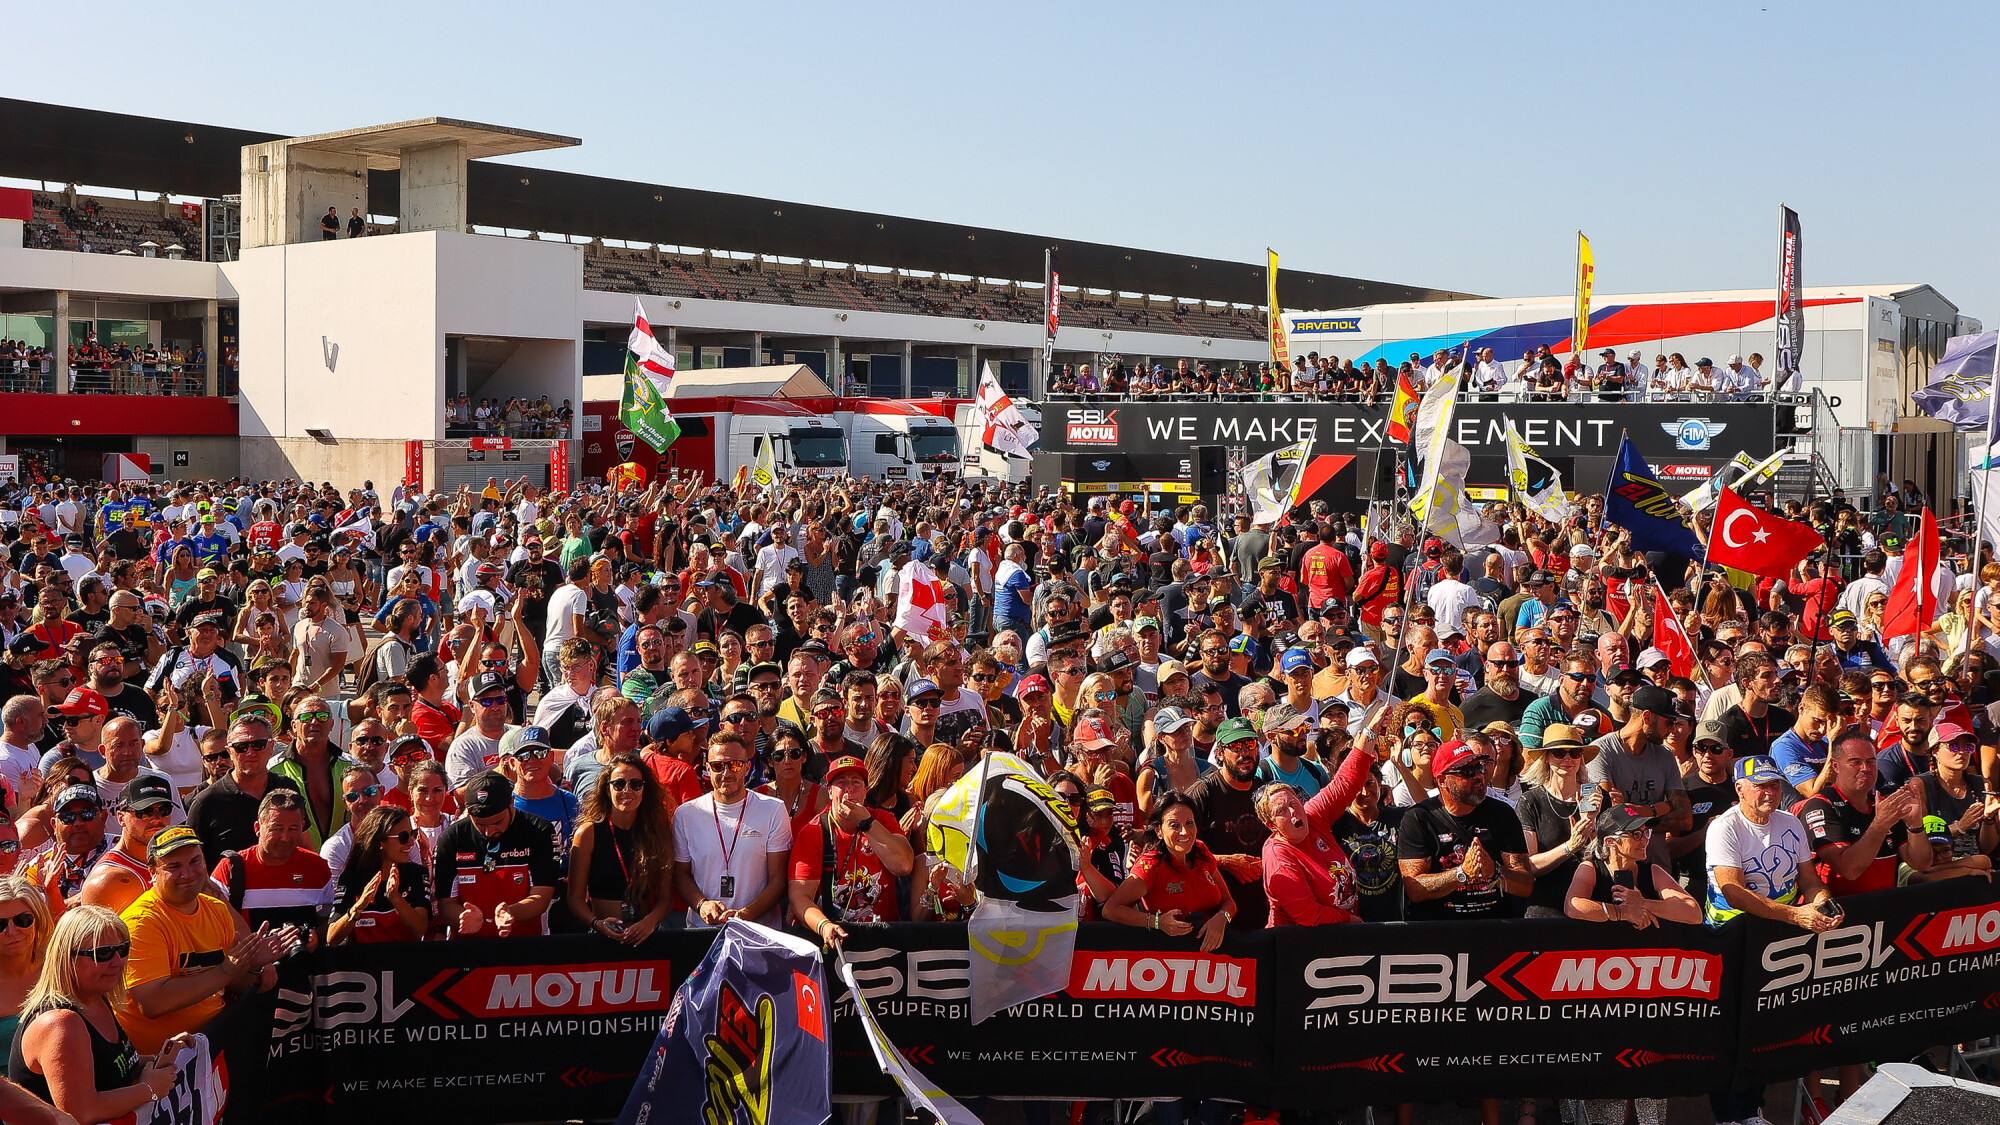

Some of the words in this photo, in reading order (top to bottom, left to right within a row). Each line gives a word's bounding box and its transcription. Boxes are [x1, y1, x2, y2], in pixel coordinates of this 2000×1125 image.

[1296, 321, 1356, 331] RAVENOL
[1067, 409, 1118, 425] SBK
[637, 417, 667, 443] Northern
[637, 428, 663, 448] Ireland
[1069, 427, 1116, 440] MOTUL
[1146, 416, 1198, 441] WE
[1213, 417, 1318, 443] MAKE
[1334, 418, 1614, 446] EXEMENT
[1683, 427, 1705, 441] FIM
[482, 437, 504, 445] MOTUL
[176, 453, 187, 461] 04
[656, 449, 678, 474] 21
[802, 467, 825, 475] DUCATI
[1647, 464, 1671, 476] BK
[1674, 466, 1709, 475] MOTUL
[1614, 483, 1651, 501] EL
[480, 672, 496, 684] 65
[1760, 912, 1924, 992] SBK
[834, 947, 972, 1004] SB
[1083, 957, 1247, 998] MOTUL
[1304, 952, 1528, 1010] SBK
[1551, 956, 1712, 992] MOTUL
[486, 968, 661, 1010] MOTUL
[1757, 992, 1785, 1012] FIM
[1790, 972, 1880, 1004] SUPERBIKE
[1886, 961, 1941, 983] WORLD
[877, 1002, 997, 1019] SUPERBI
[1008, 1003, 1083, 1019] WORLD
[1094, 1003, 1255, 1027] CHAMPIONSHIP
[1304, 1012, 1339, 1030] FIM
[1348, 1007, 1467, 1025] SUPERBIKE
[1477, 1005, 1551, 1022] WORLD
[1561, 1001, 1721, 1019] CHAMPIONSHIP
[1839, 1022, 1858, 1036] WE
[1861, 1014, 1896, 1031] MAKE
[1900, 1000, 1977, 1023] EXCITEMENT
[289, 1028, 396, 1054] SUPERBIKE
[406, 1023, 487, 1043] WORLD
[947, 1050, 971, 1061] WE
[978, 1050, 1025, 1062] MAKE
[1031, 1050, 1138, 1062] EXCITEMENT
[1416, 1056, 1440, 1067] WE
[1446, 1055, 1492, 1066] MAKE
[1499, 1052, 1603, 1065] EXCITEMENT
[343, 1080, 369, 1092] WE
[376, 1077, 427, 1090] MAKE
[433, 1072, 547, 1088] EXCITEMENT
